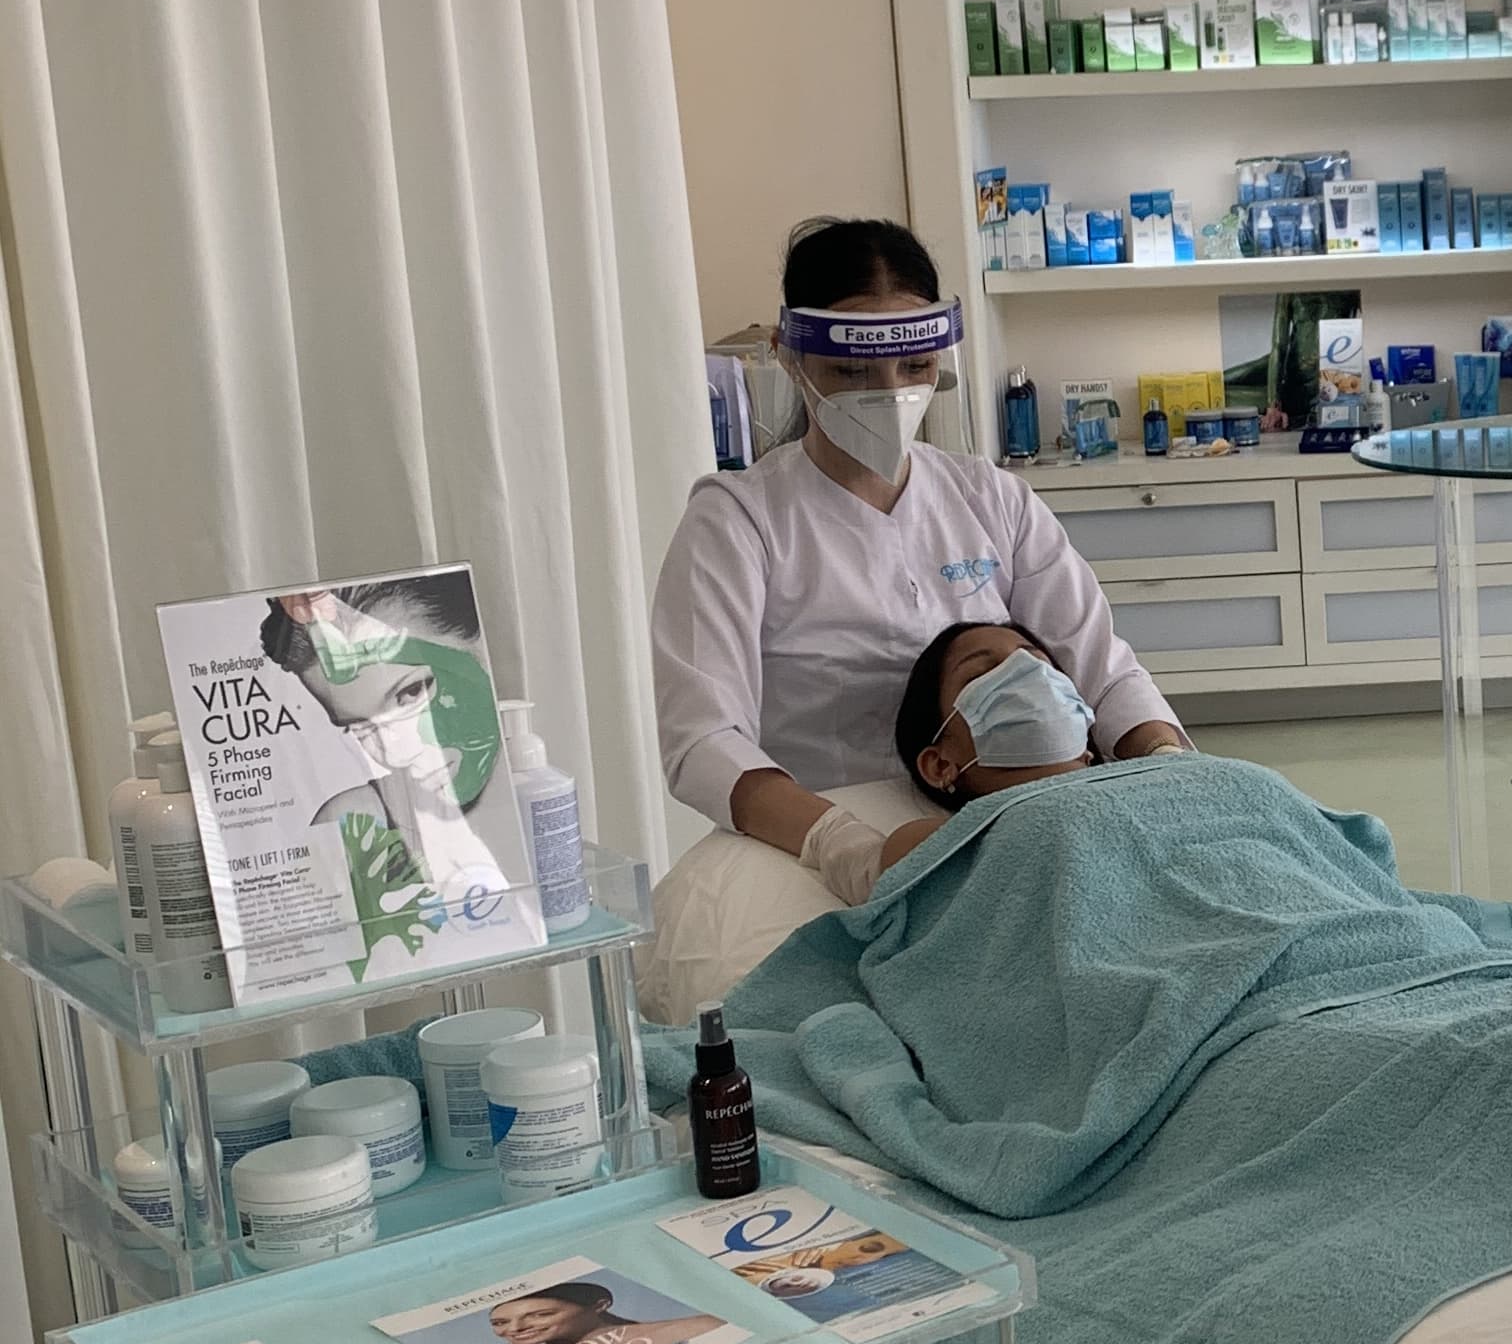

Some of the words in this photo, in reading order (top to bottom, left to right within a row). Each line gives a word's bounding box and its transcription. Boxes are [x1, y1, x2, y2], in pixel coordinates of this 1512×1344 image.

[845, 326, 885, 342] Face
[890, 321, 938, 341] Shield
[850, 346, 874, 354] Direct
[875, 344, 901, 355] Splash
[1065, 383, 1079, 394] DRY
[189, 663, 208, 677] The
[192, 675, 272, 712] VITA
[202, 704, 301, 744] CURA
[208, 751, 218, 767] 5
[223, 746, 272, 765] Phase
[210, 765, 272, 785] Firming
[213, 779, 262, 803] Facial
[227, 857, 252, 873] TONE
[260, 851, 278, 867] LIFT
[287, 846, 311, 861] FIRM
